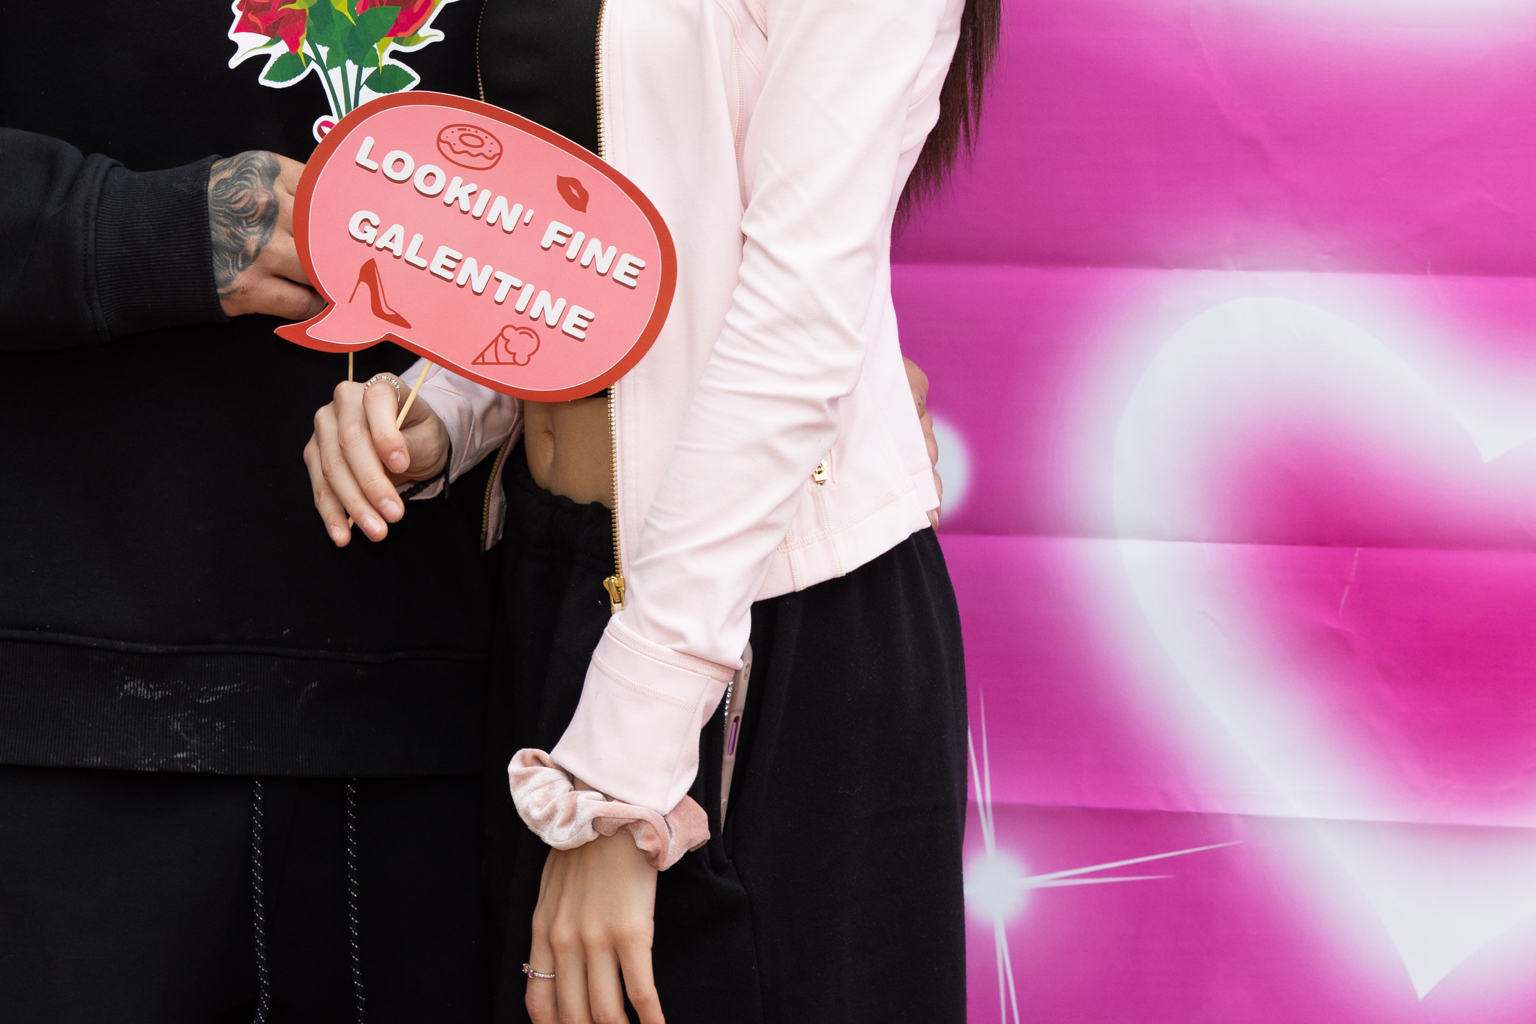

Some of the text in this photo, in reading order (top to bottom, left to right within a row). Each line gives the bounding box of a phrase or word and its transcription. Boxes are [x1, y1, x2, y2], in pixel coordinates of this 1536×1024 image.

[348, 209, 596, 343] GALENTINE
[355, 136, 646, 290] LOOKIN' FINE
